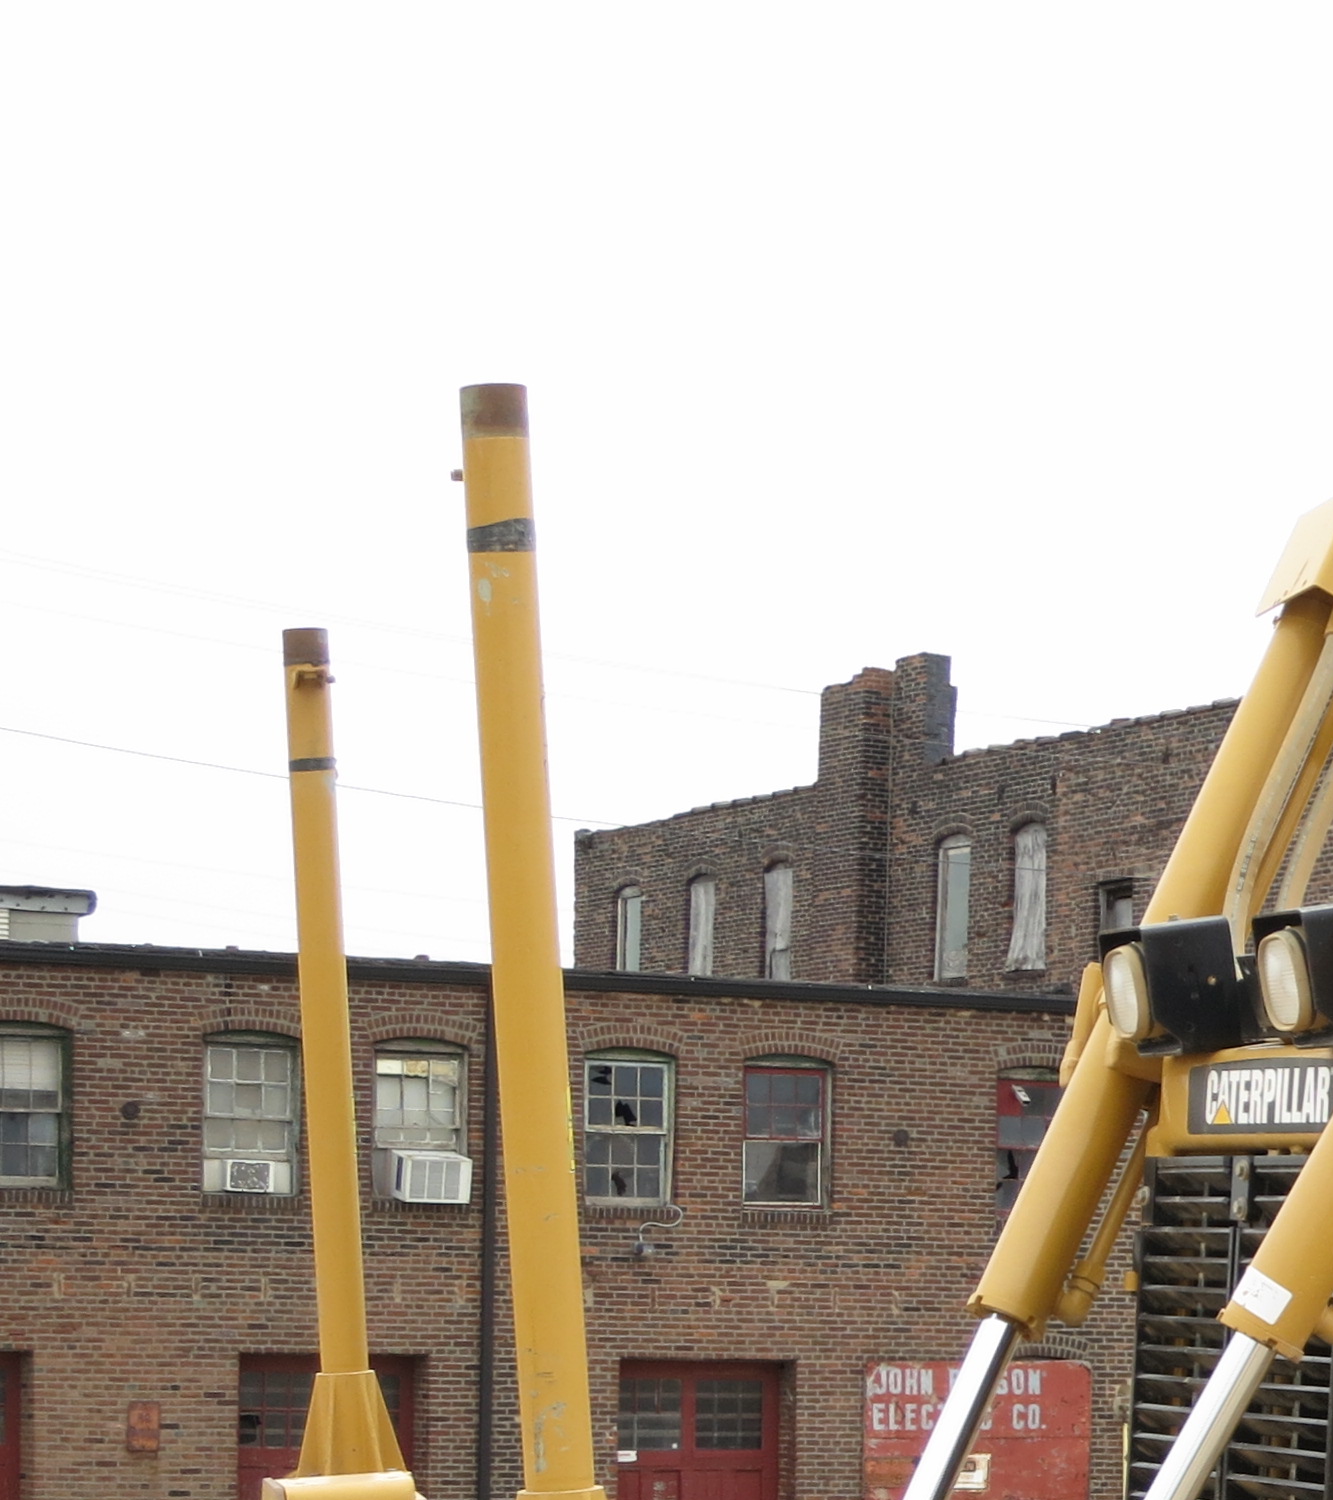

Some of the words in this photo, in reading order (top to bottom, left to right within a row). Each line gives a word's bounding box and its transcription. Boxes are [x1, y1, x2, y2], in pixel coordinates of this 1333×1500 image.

[1205, 1066, 1331, 1126] CATERPILLAR
[873, 1368, 934, 1396] JOHN
[1012, 1403, 1048, 1431] CO.
